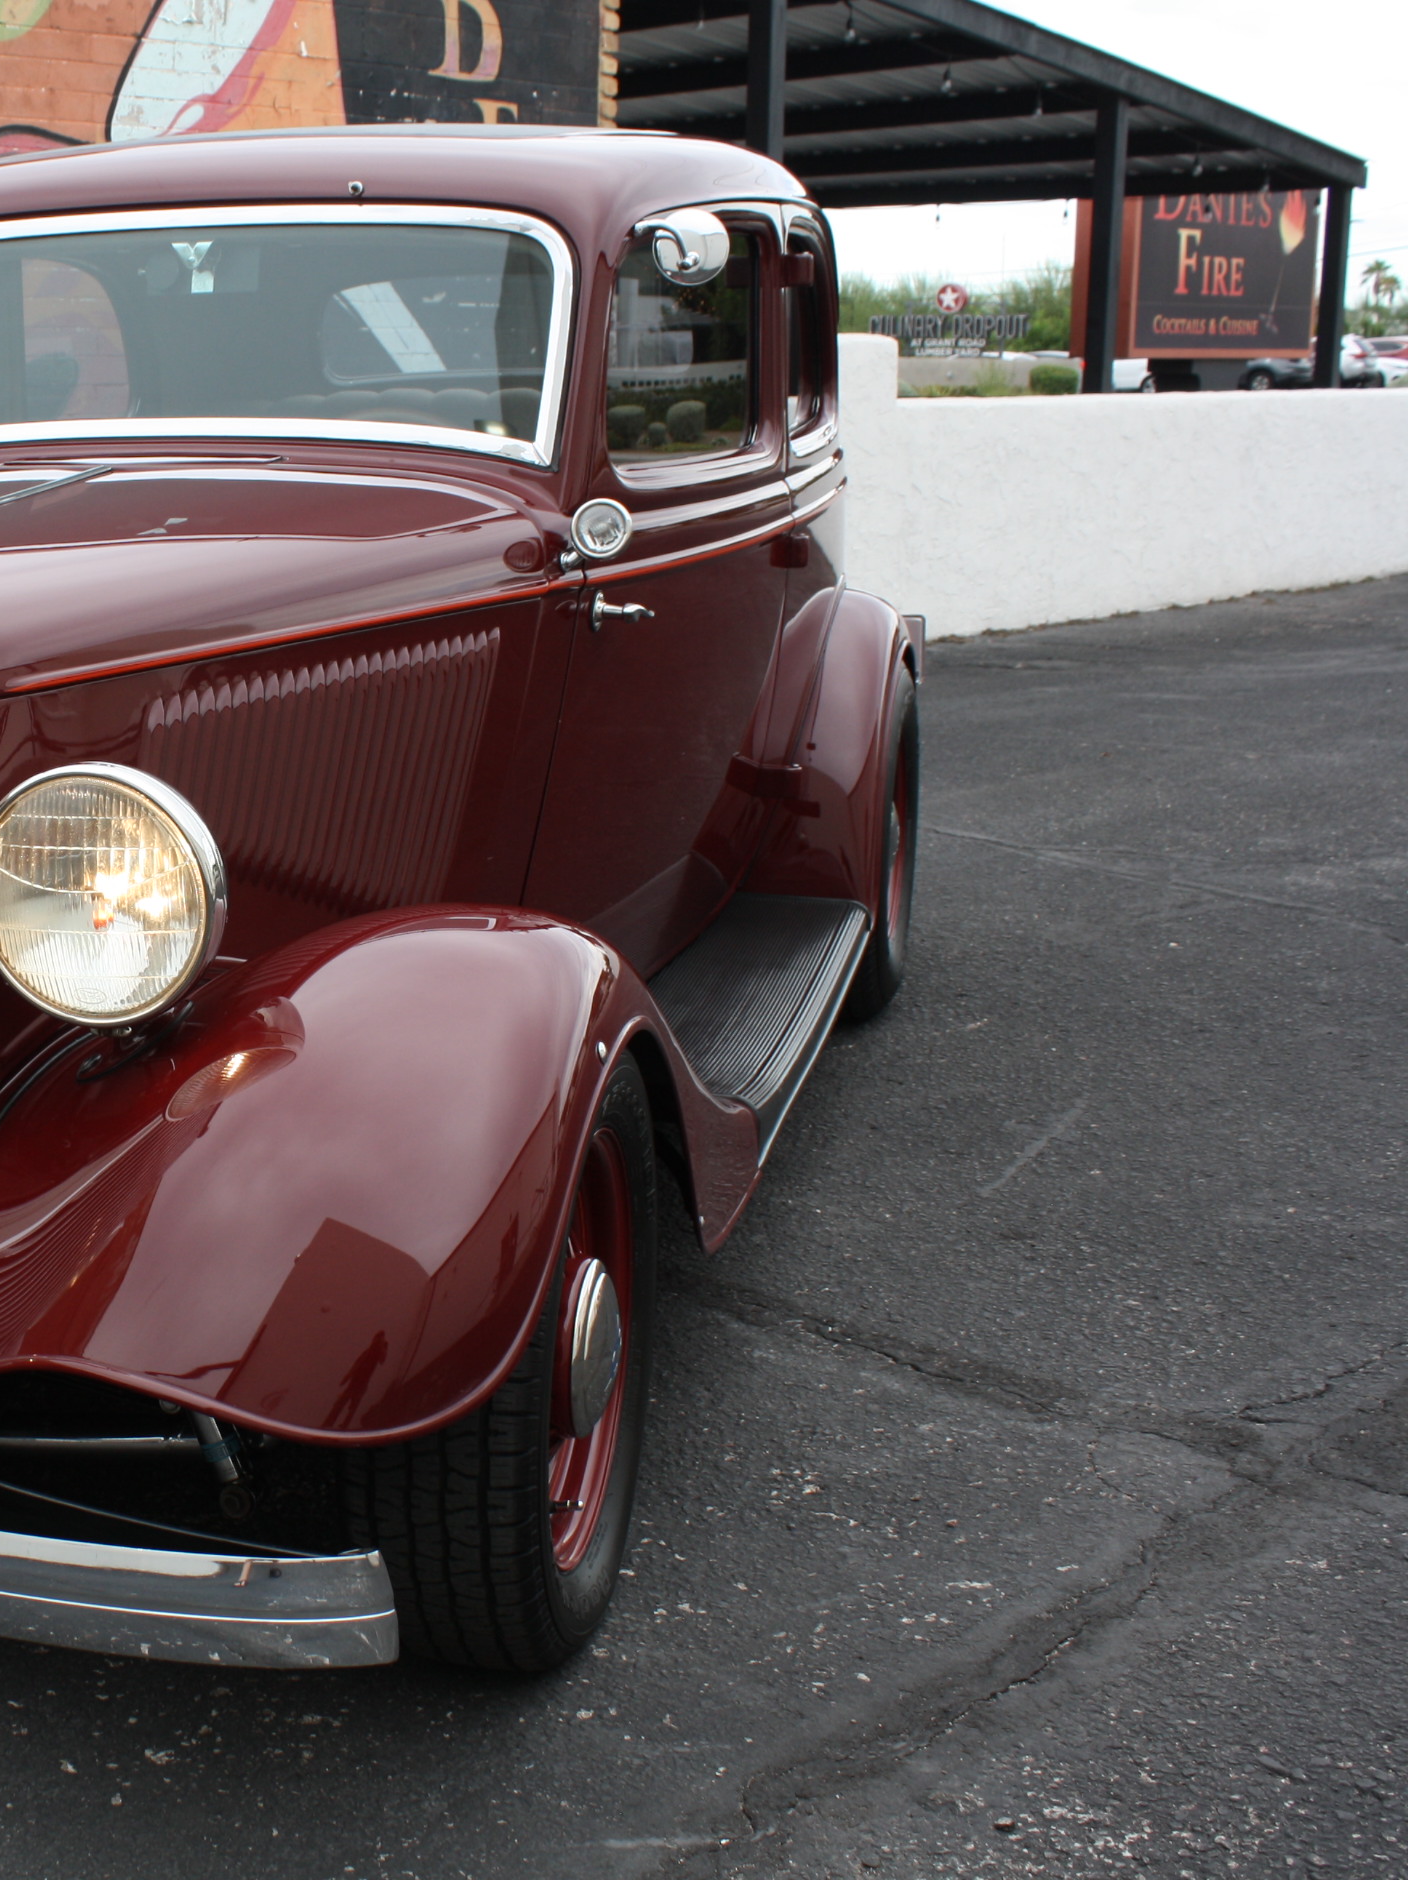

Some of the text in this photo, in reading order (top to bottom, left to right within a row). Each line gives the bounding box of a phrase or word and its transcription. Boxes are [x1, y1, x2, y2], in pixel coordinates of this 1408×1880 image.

[1154, 193, 1273, 228] ANTES
[1174, 227, 1245, 297] FIRE
[869, 314, 1029, 339] CULINARY DROPOUT
[1153, 314, 1259, 336] COCKTAILS & CUISINE
[910, 338, 987, 348] AT GRANT ROAD
[915, 347, 981, 357] LUMBER YARD
